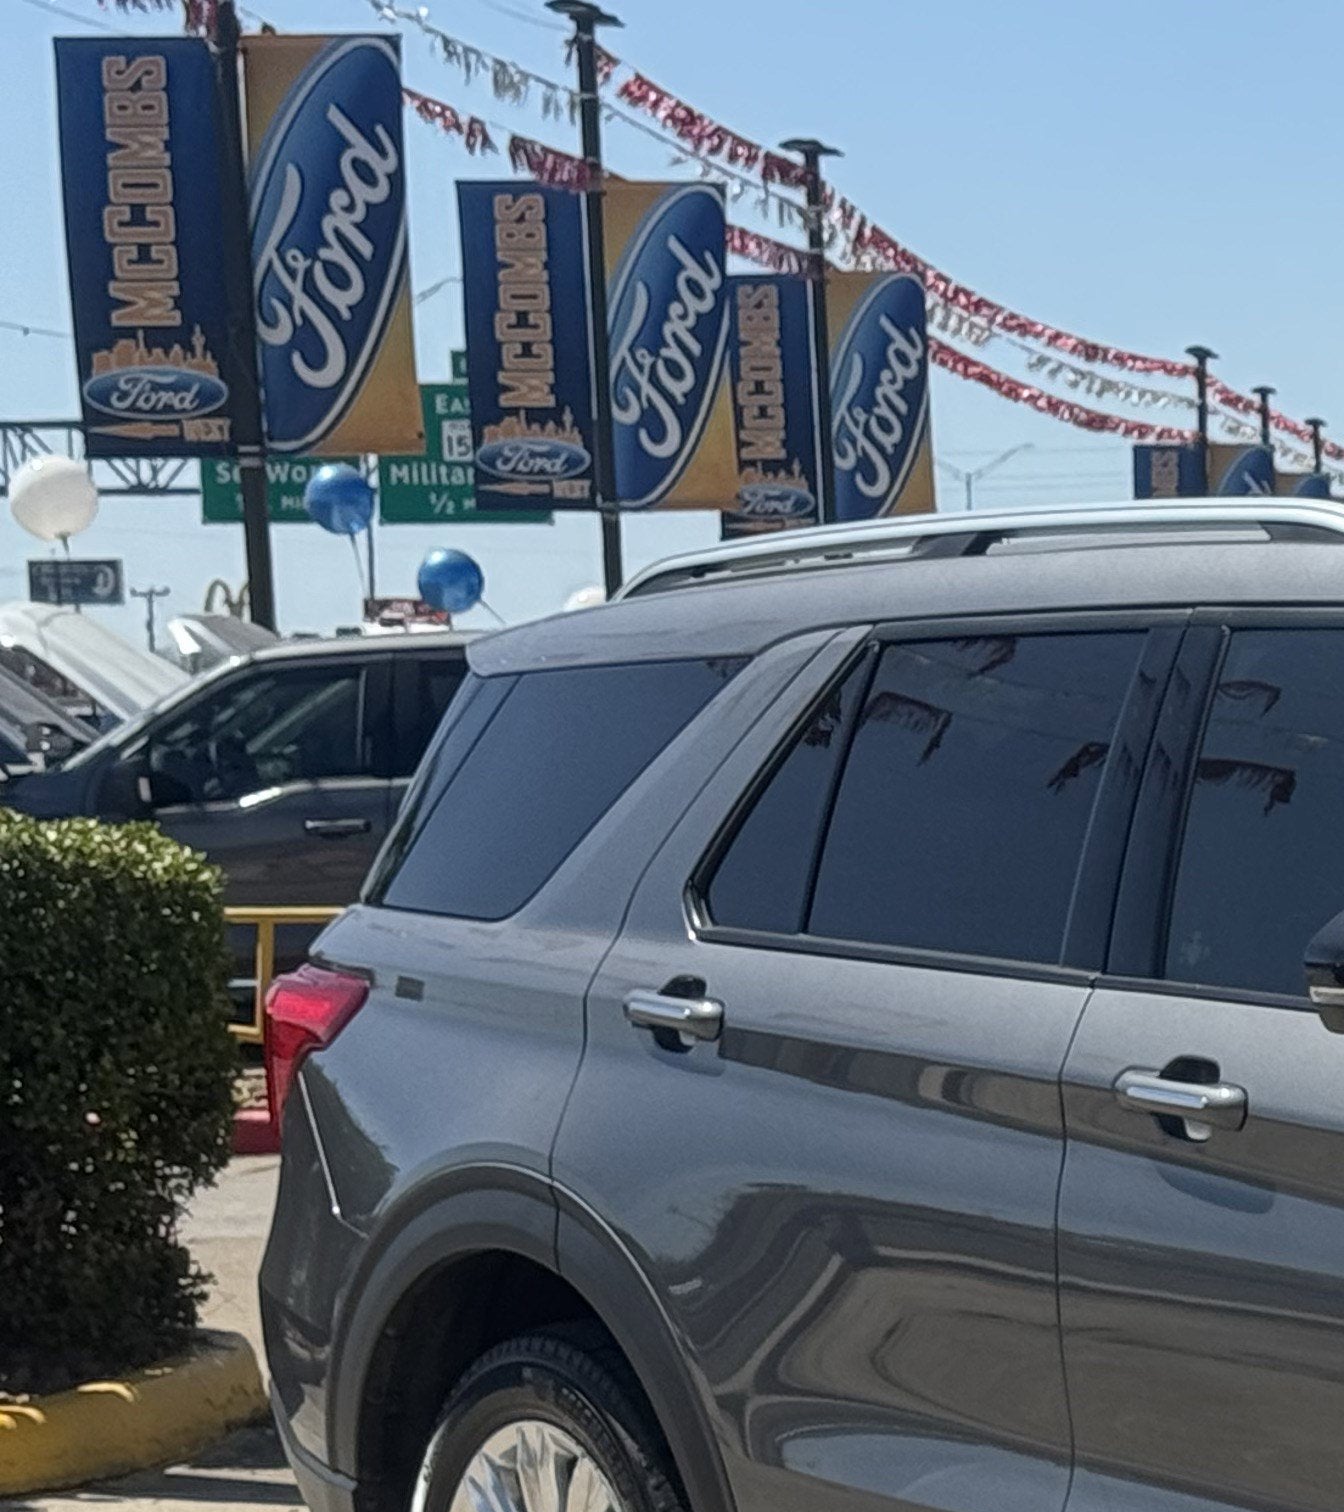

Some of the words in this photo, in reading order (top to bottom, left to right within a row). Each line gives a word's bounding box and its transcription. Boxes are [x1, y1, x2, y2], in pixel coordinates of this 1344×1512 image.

[101, 55, 182, 327] MCCOMBS
[253, 102, 399, 389] Ford
[110, 373, 201, 411] Ford
[493, 193, 557, 408] MCCOMBS
[608, 233, 723, 459] Ford
[736, 284, 788, 461] MCCOMBS
[495, 441, 569, 473] Ford
[830, 313, 924, 498] Ford
